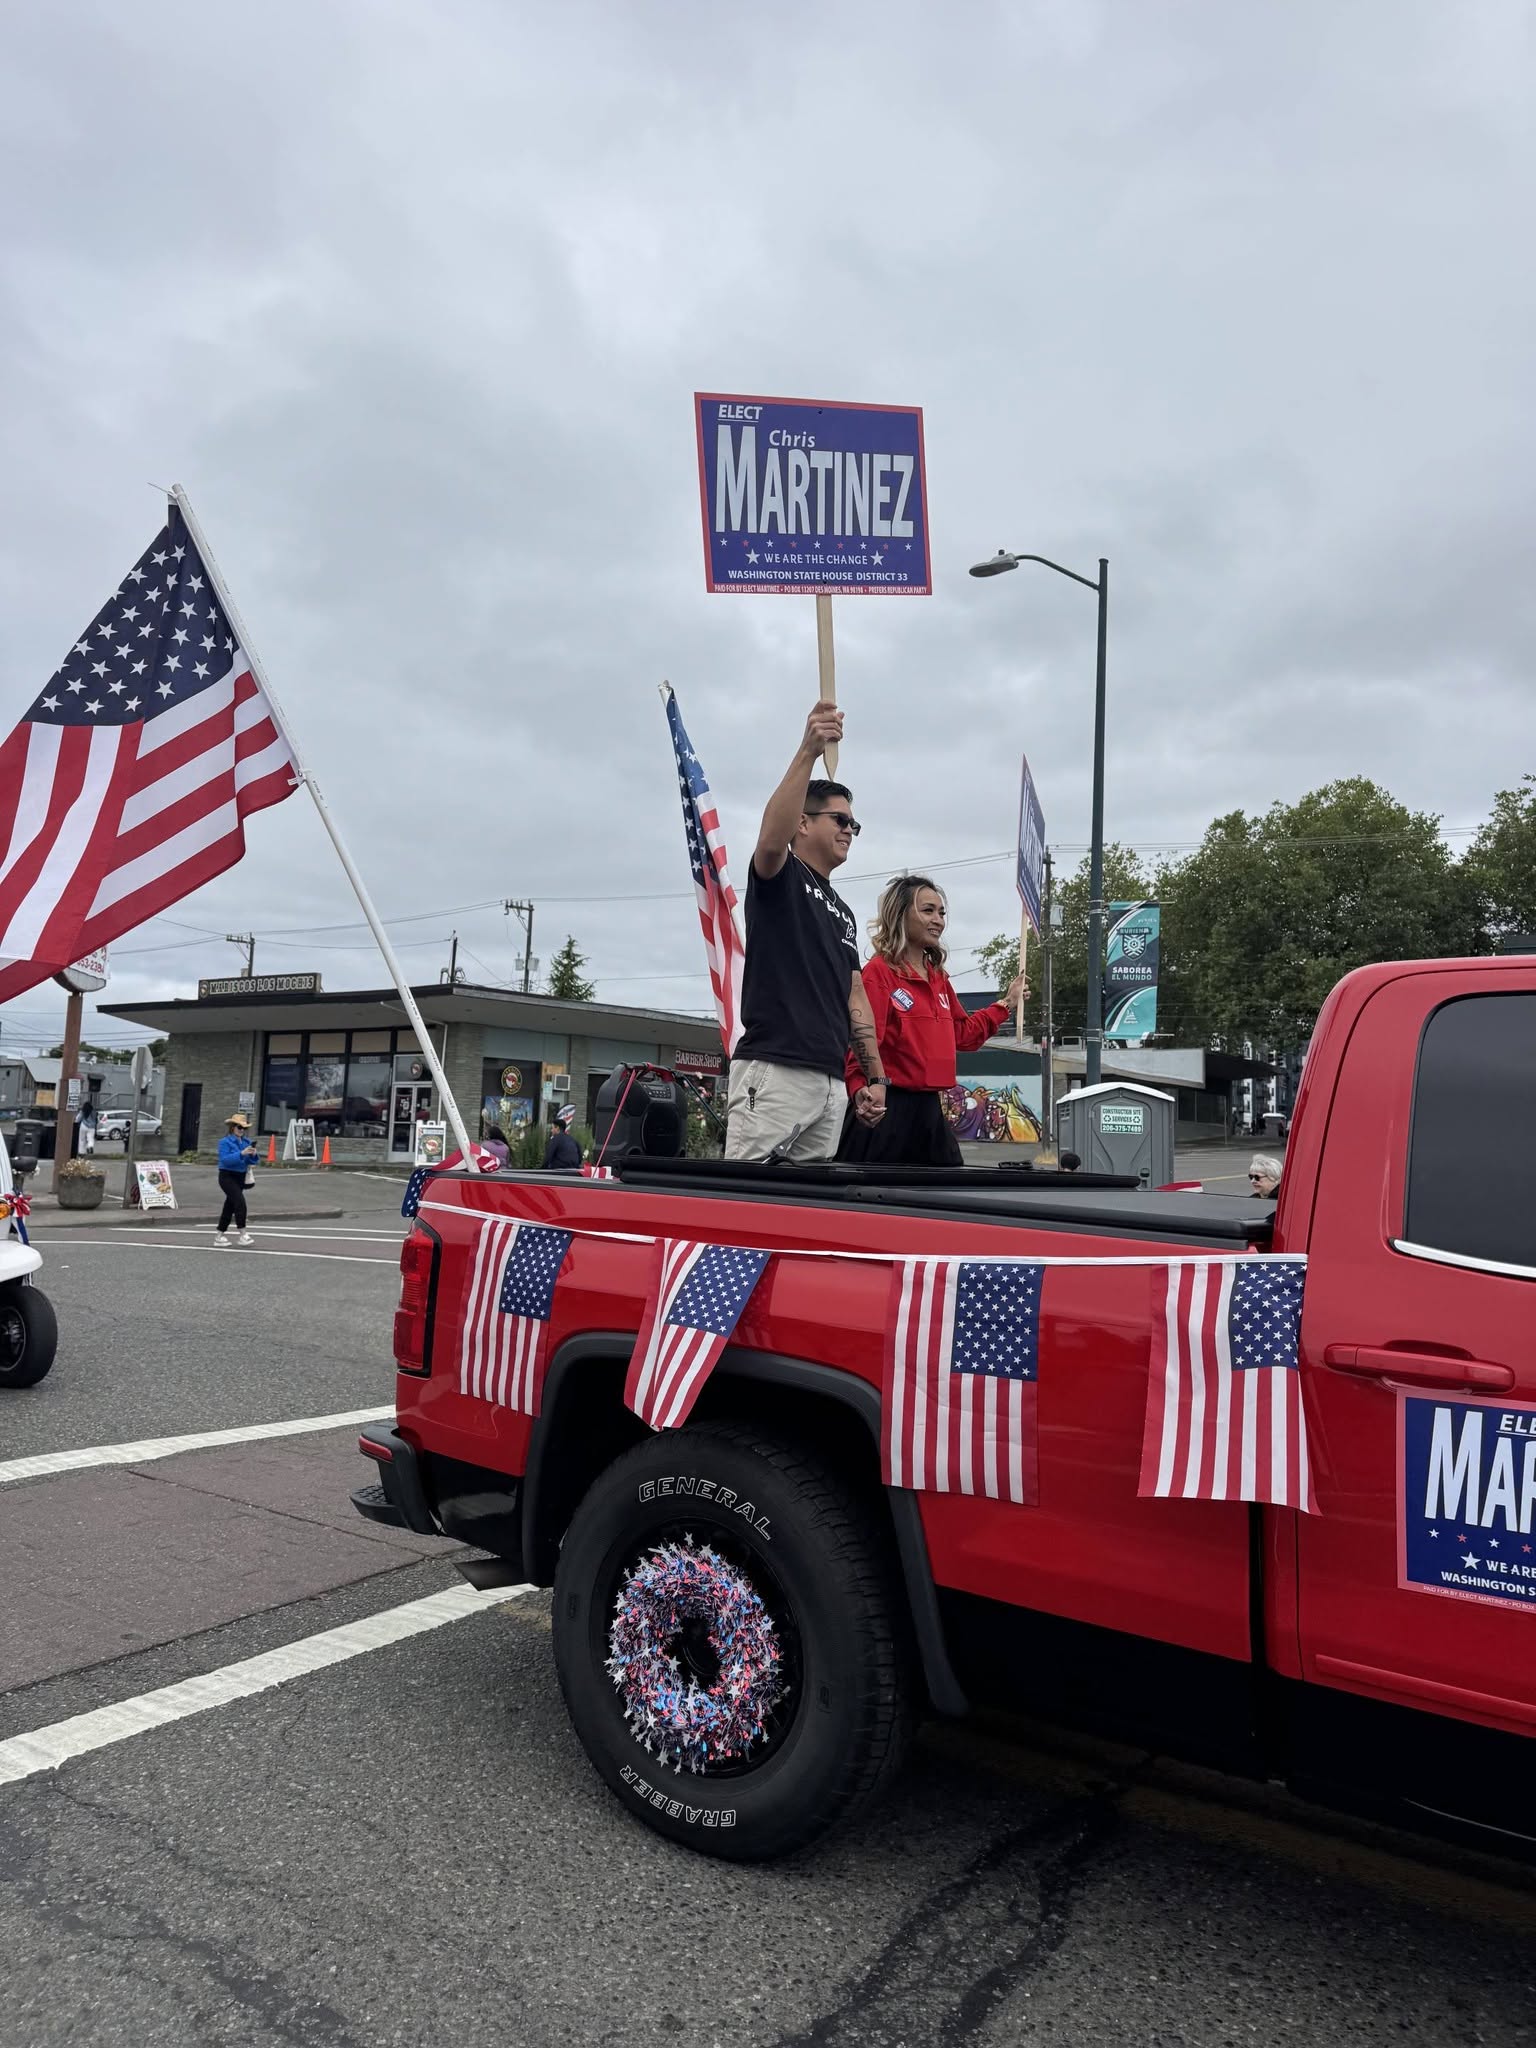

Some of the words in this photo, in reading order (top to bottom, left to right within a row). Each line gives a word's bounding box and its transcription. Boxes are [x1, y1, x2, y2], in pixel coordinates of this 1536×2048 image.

[718, 404, 763, 420] ELECT
[769, 429, 816, 448] Chris
[715, 424, 914, 537] MARTINEZ
[764, 553, 780, 563] WE
[782, 553, 803, 564] ARE
[805, 554, 824, 564] THE
[826, 554, 868, 565] CHANGE
[728, 570, 791, 580] WASHINGTON
[793, 571, 820, 580] STATE
[822, 571, 853, 581] HOUSE
[856, 572, 896, 581] DISTRICT
[897, 573, 908, 581] 33
[714, 584, 725, 592] PAID
[726, 584, 736, 592] FOR
[1112, 966, 1153, 974] SABOREA
[256, 978, 276, 992] LOS
[638, 1476, 772, 1541] GENERAL
[1485, 1560, 1508, 1573] WE
[1510, 1564, 1536, 1578] ARE
[1441, 1571, 1526, 1595] WASHINGTON
[1459, 1591, 1478, 1600] ELECT
[1478, 1595, 1508, 1606] MARTINEZ
[619, 1764, 737, 1827] GRABBER
